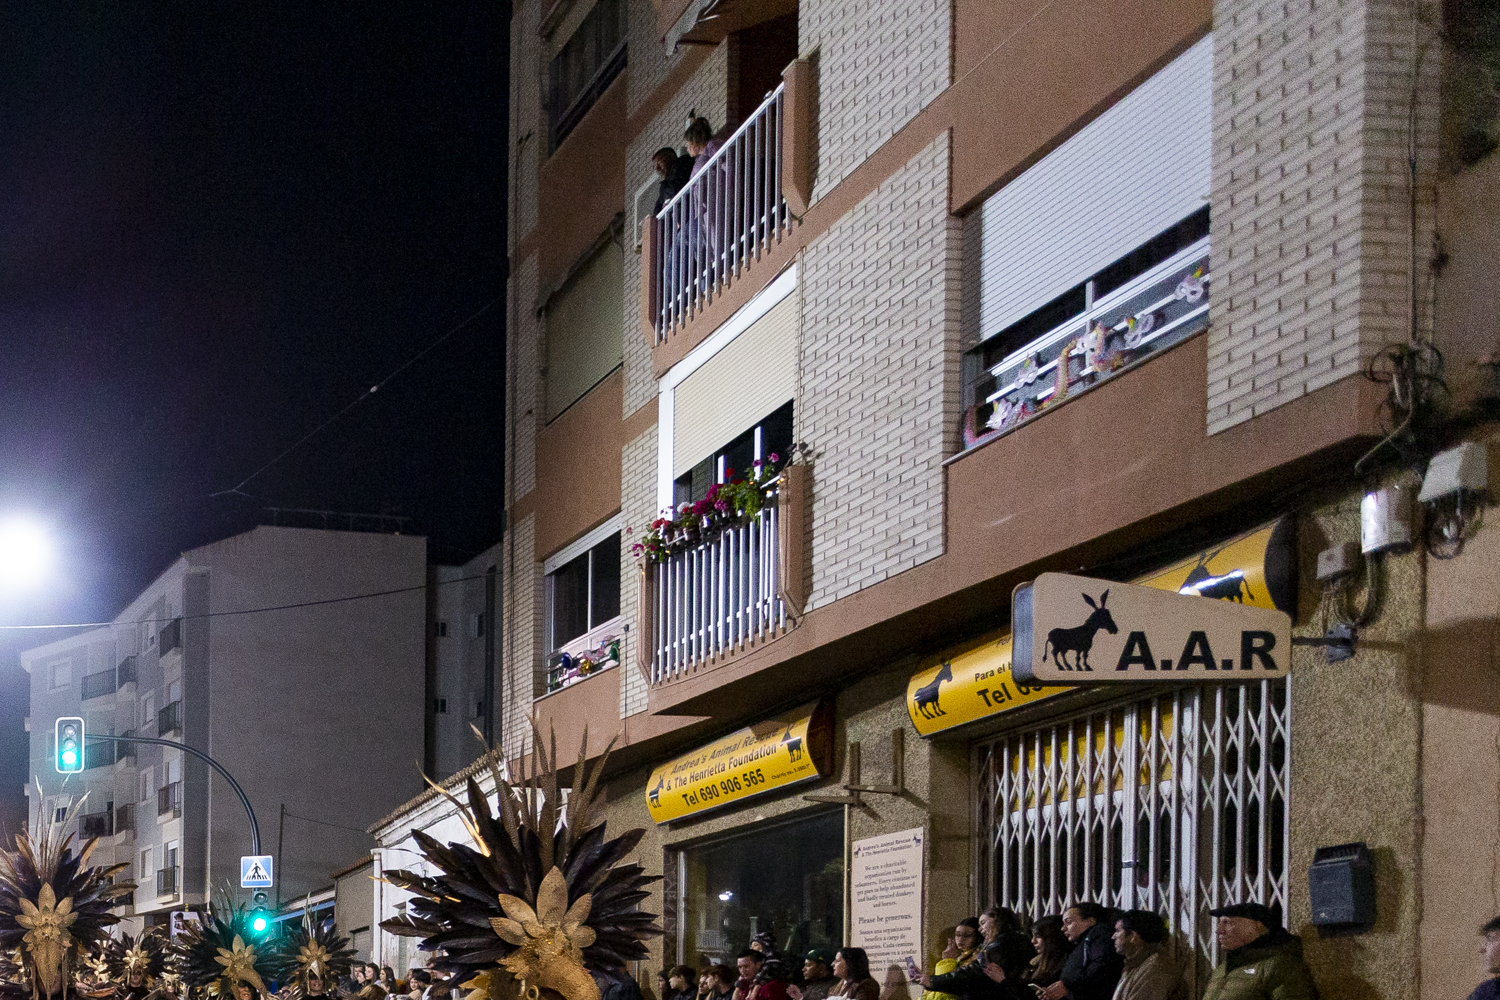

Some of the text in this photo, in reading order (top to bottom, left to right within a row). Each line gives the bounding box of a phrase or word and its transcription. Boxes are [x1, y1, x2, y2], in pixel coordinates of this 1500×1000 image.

[1115, 630, 1279, 671] A.A.R
[974, 669, 994, 682] Para
[997, 663, 1006, 674] el
[976, 682, 1013, 707] Tel
[666, 780, 672, 791] &
[674, 776, 688, 788] The
[689, 762, 726, 784] Henrietta
[728, 743, 777, 770] Foundation
[671, 754, 708, 774] Andrea's
[709, 740, 740, 761] Animal
[682, 768, 766, 806] Tel 690 906 565
